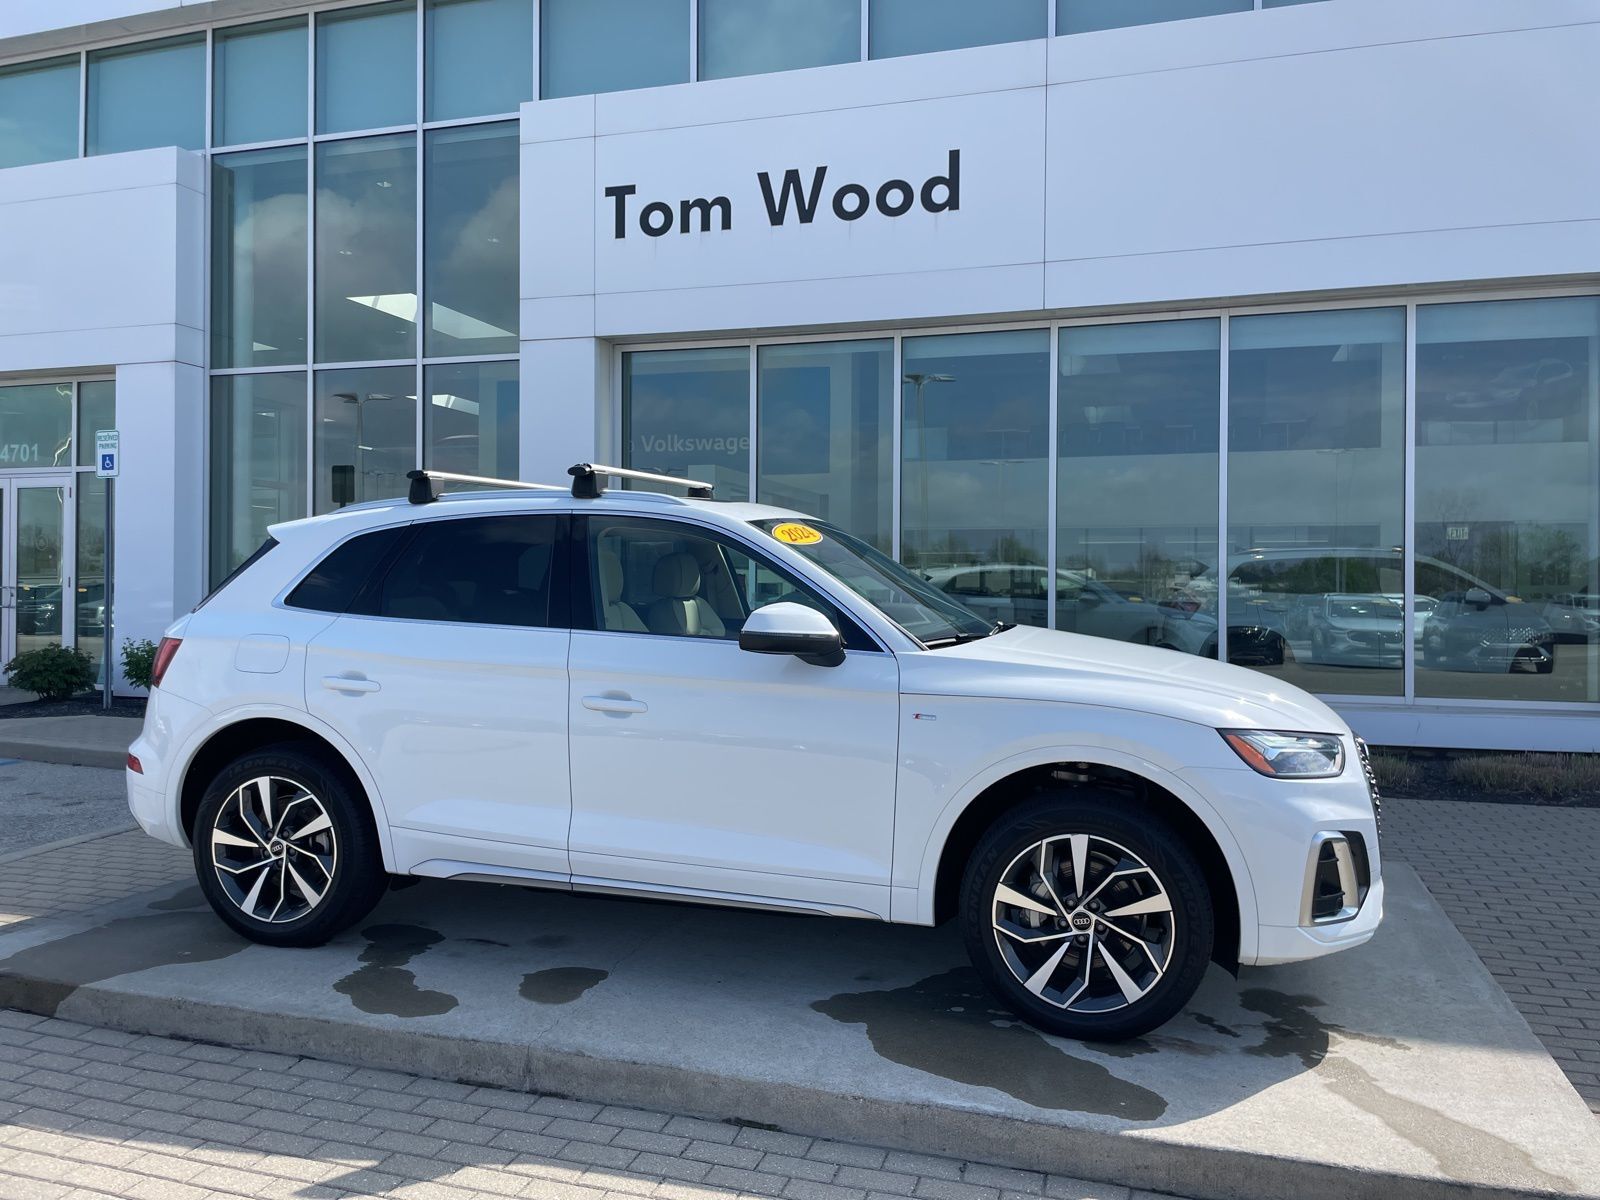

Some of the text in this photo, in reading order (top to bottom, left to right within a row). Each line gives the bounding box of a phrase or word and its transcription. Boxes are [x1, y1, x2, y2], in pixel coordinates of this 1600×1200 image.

[604, 148, 961, 239] Tom Wood
[0, 443, 39, 462] 4701
[640, 434, 750, 455] Volkswage
[781, 526, 817, 542] 2024
